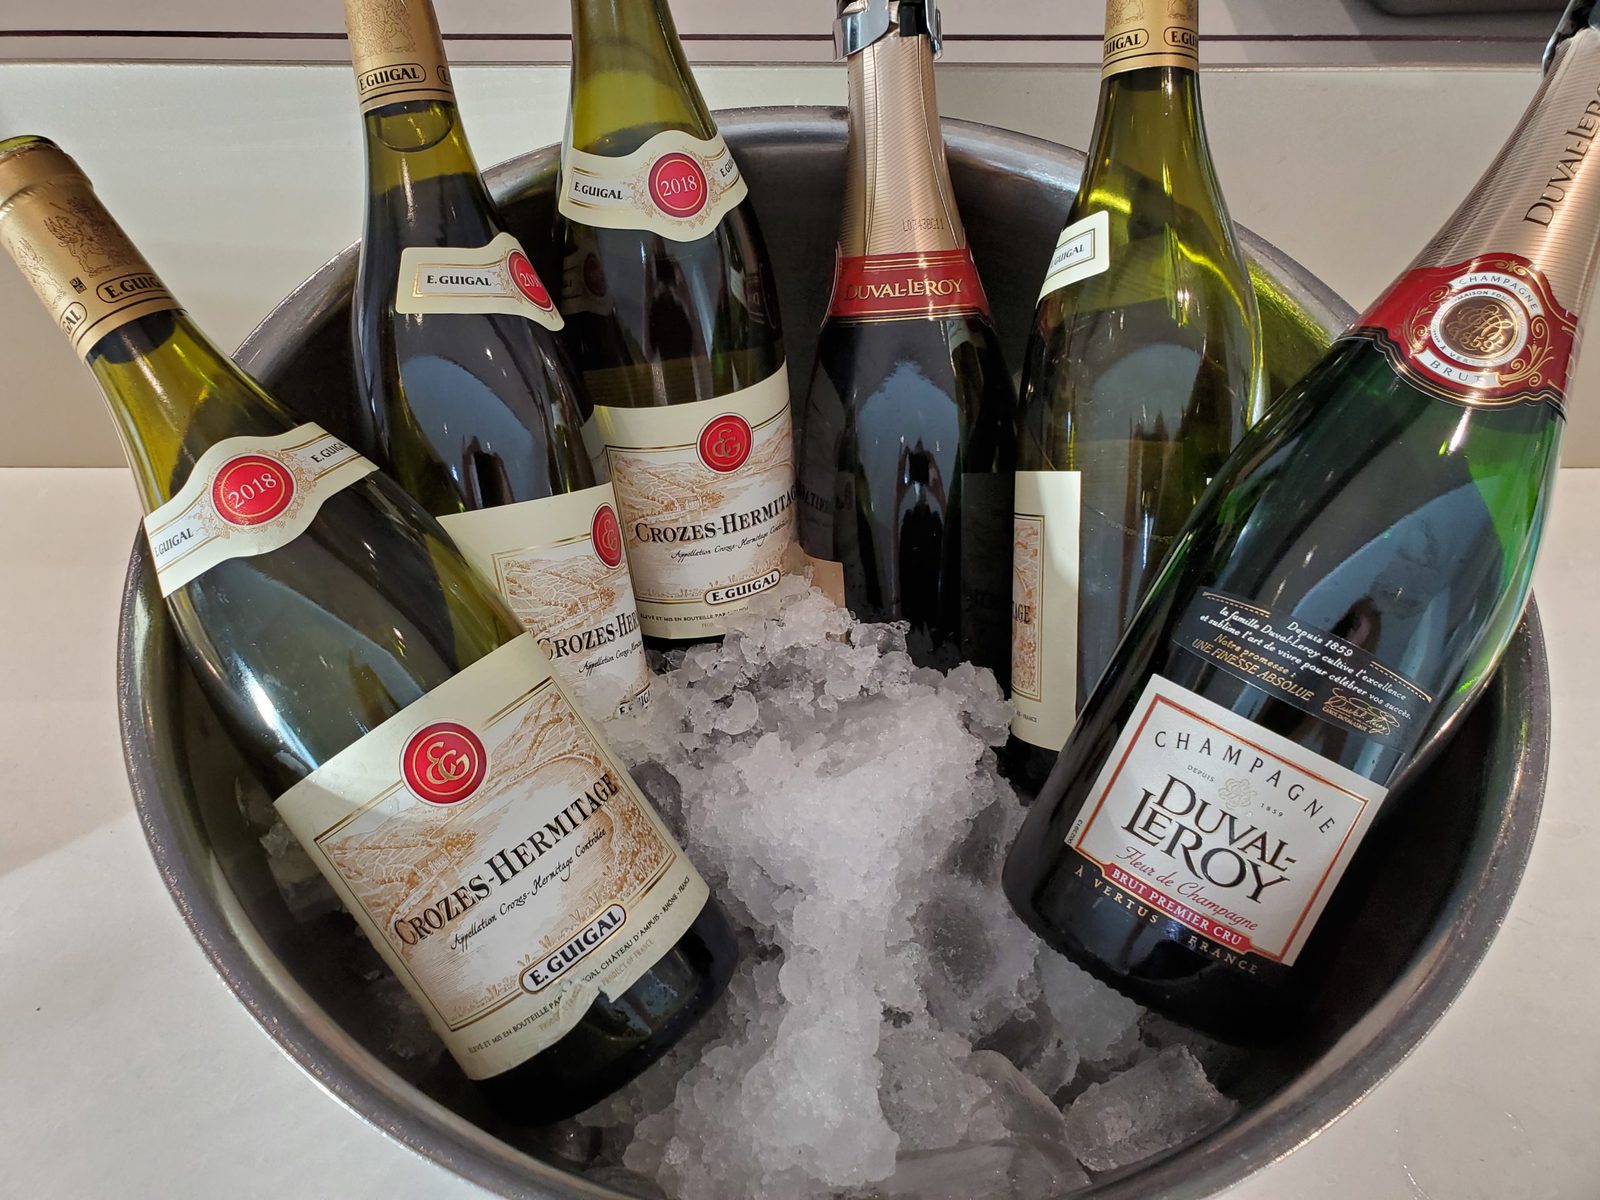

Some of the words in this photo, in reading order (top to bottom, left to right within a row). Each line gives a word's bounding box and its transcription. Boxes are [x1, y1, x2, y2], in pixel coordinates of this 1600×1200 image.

[1522, 84, 1600, 228] DUVAL-LER
[574, 182, 624, 200] E.GUIGAL
[661, 175, 697, 197] 2018
[427, 275, 492, 286] E.GUIGAL
[848, 278, 963, 299] DUVAL-LEROY
[1459, 275, 1539, 310] CHAMPAGNE
[1431, 360, 1482, 380] BRUT
[228, 472, 277, 509] 2018
[671, 549, 711, 563] Appellation
[712, 573, 777, 602] E.GUIGAL
[683, 614, 713, 622] BOUTEILLE
[1287, 621, 1323, 643] Depuis
[1324, 639, 1354, 657] 1859
[578, 656, 614, 677] Appellation
[1191, 638, 1212, 655] UNE
[1211, 645, 1260, 674] FINESSE
[1257, 667, 1315, 701] ABSOLUE
[1200, 614, 1208, 622] et
[1208, 617, 1241, 636] sublime
[1241, 629, 1261, 646] l'art
[1263, 641, 1276, 652] de
[1278, 649, 1302, 665] vivre
[1300, 661, 1328, 676] pour
[1329, 672, 1368, 696] célébrer
[1369, 694, 1384, 705] vos
[1384, 700, 1412, 720] succès.
[1214, 633, 1241, 651] Notre
[1240, 647, 1290, 675] promesse
[1227, 608, 1260, 631] famille
[1260, 624, 1320, 658] Duval-Leroy
[1321, 651, 1354, 674] cultive
[1357, 669, 1407, 701] l'excellence
[1155, 730, 1336, 834] CHAMPAGNE
[1187, 764, 1215, 782] DEPUIS
[1260, 803, 1284, 817] 1859
[1120, 788, 1290, 904] LEROY
[1154, 774, 1296, 872] DUVAL-
[393, 773, 619, 945] CROZES-HERMITAGE
[1115, 845, 1156, 877] Fleur
[1156, 871, 1178, 887] de
[1177, 882, 1258, 931] Champagne
[450, 914, 498, 952] Appellation
[499, 857, 573, 916] Crozes-Hermitage
[1094, 878, 1159, 923] VERTUS
[1188, 935, 1258, 975] FRANCE
[1111, 868, 1147, 895] BRUT
[1149, 891, 1210, 931] PREMIER
[1213, 926, 1243, 946] CRU
[501, 1028, 512, 1038] EN
[511, 1005, 550, 1032] BOUTEILLE
[598, 939, 635, 970] CHÂTEAU
[632, 914, 660, 941] D'AMPUIS
[529, 909, 622, 987] E.GUIGAL
